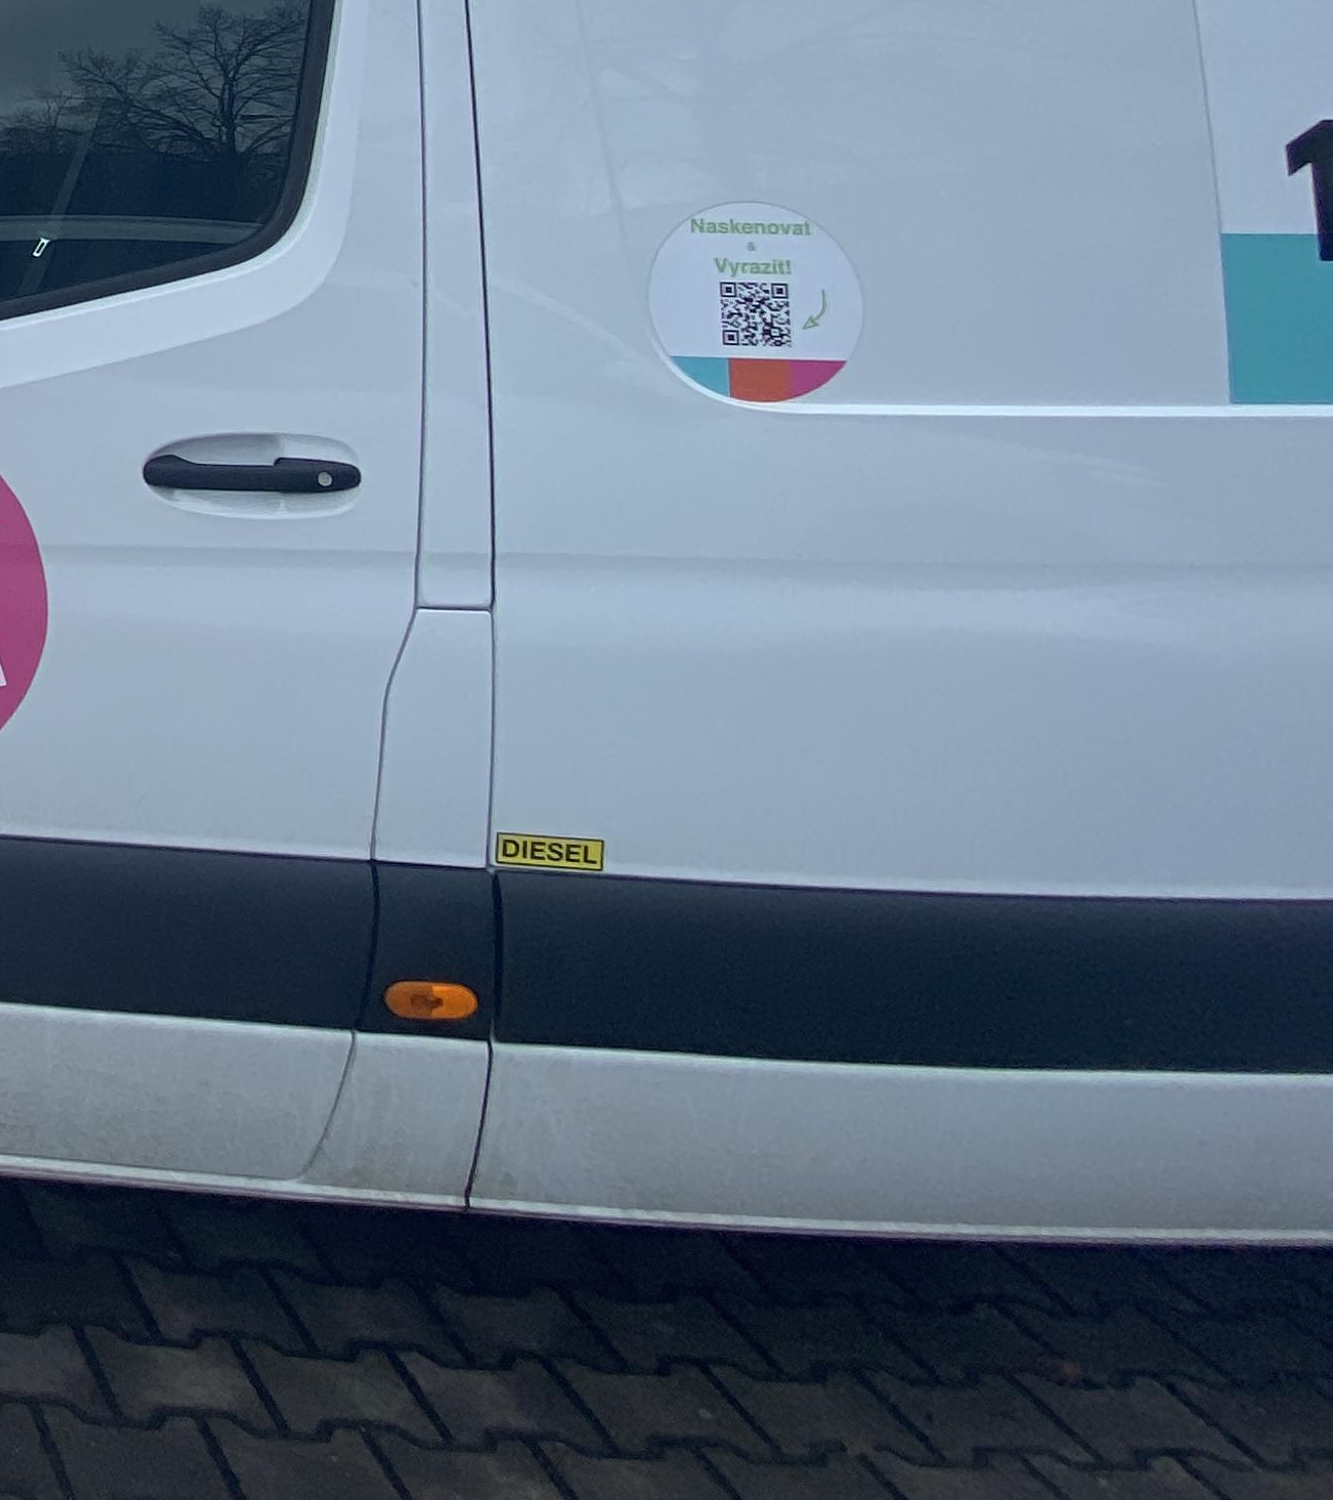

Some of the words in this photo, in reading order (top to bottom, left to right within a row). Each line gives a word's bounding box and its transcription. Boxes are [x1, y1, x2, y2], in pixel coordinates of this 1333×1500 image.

[690, 218, 812, 236] Naskenovat
[747, 241, 757, 251] &
[714, 257, 792, 277] Vyrazit!
[501, 839, 597, 864] DIESEL
